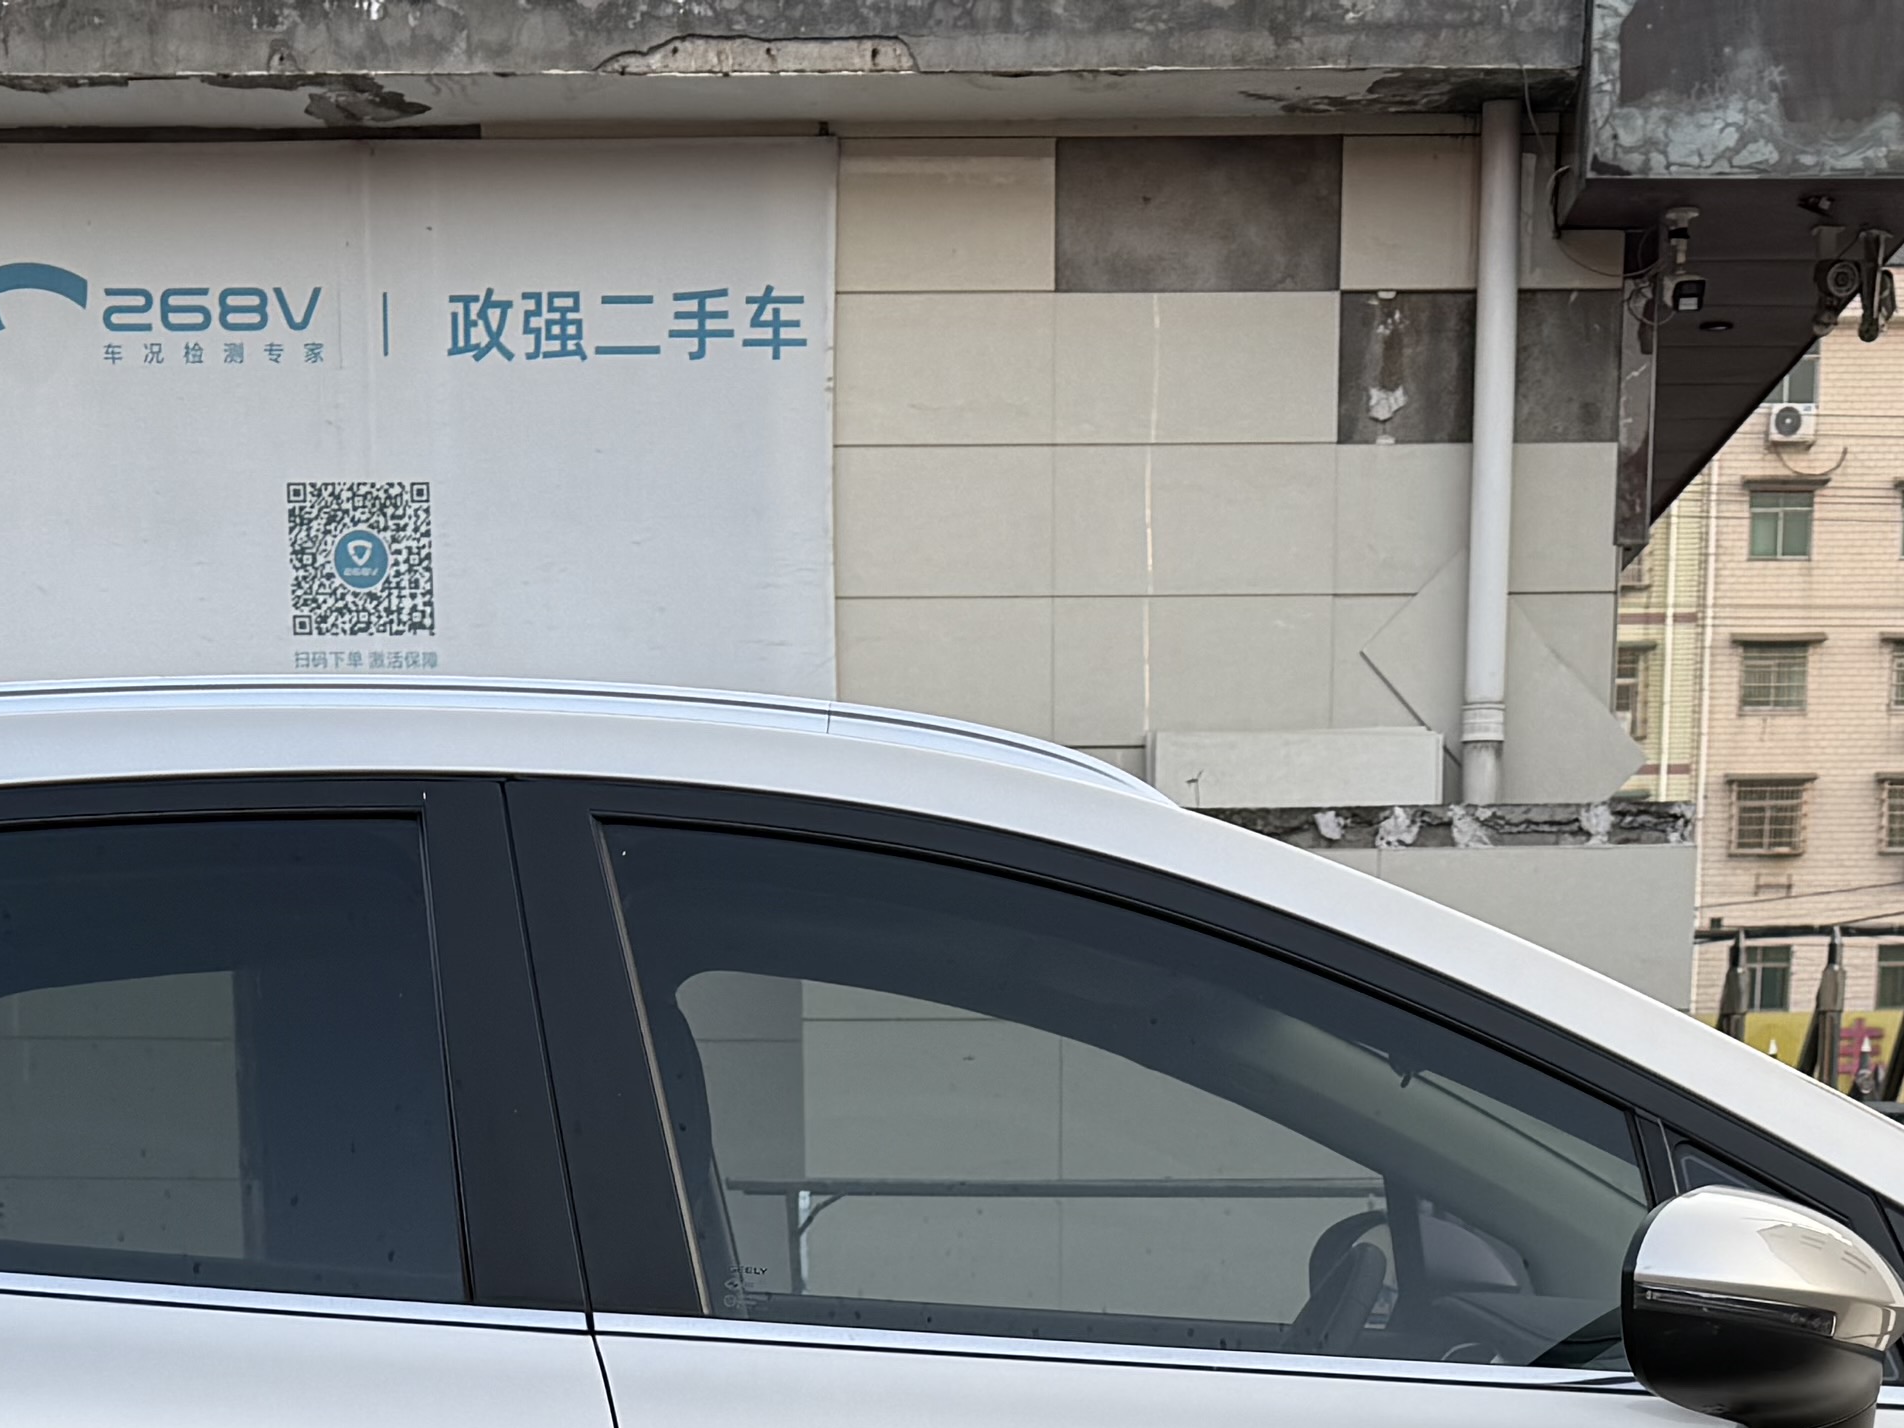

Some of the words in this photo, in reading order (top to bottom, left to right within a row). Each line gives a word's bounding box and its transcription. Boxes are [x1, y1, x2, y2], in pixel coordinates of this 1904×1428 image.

[102, 287, 322, 332] 268V
[447, 284, 808, 362] 政强二手车
[103, 342, 325, 365] 车况检测专家
